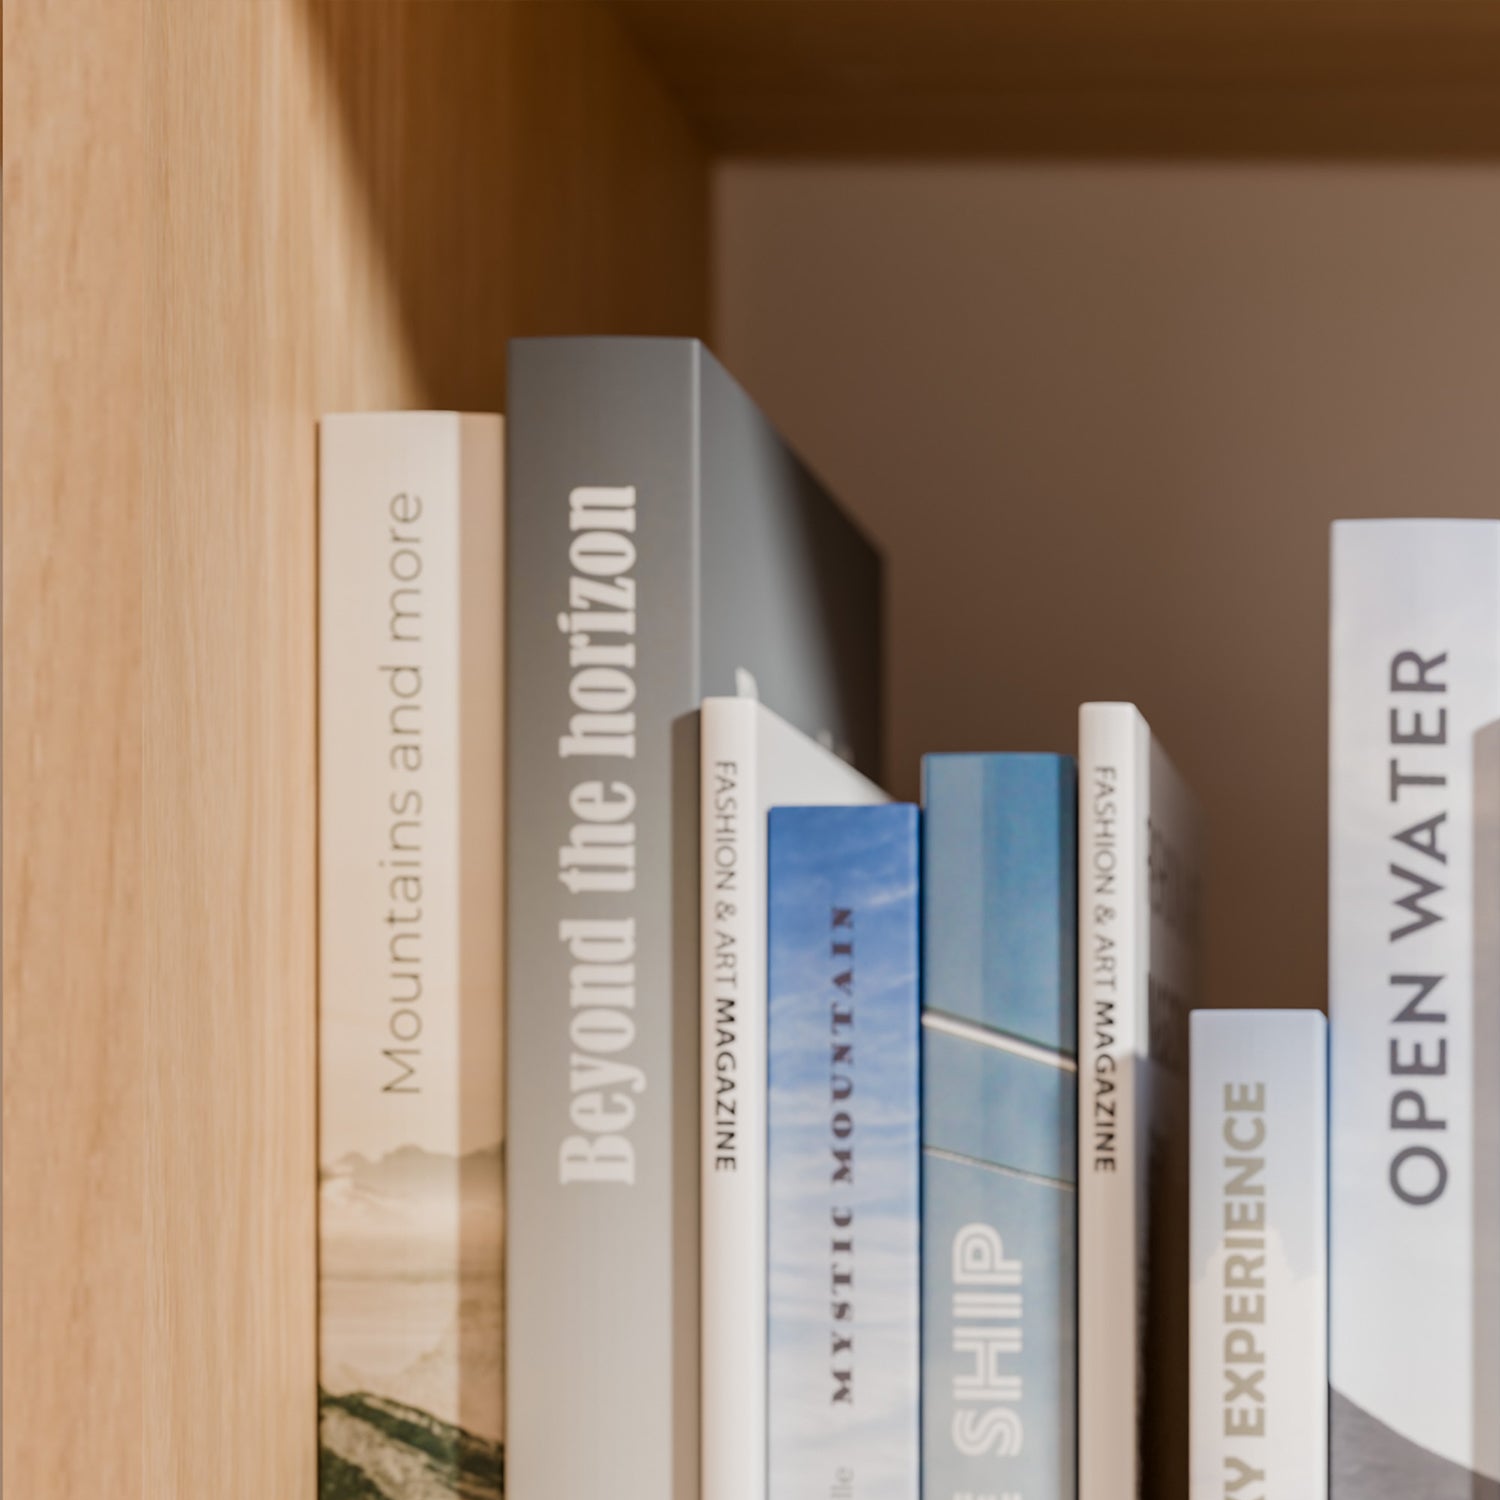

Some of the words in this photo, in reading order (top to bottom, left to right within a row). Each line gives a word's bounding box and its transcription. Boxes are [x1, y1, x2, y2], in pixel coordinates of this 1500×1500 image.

[388, 492, 422, 643] more
[558, 485, 637, 759] horizon
[379, 665, 422, 773] and
[1389, 648, 1448, 944] WATER
[559, 781, 637, 893] the
[714, 760, 736, 891] FASHION
[714, 901, 736, 921] &
[1093, 765, 1116, 896] FASHION
[379, 790, 422, 1094] Mountains
[714, 930, 736, 988] ART
[1093, 904, 1116, 925] &
[1093, 933, 1116, 990] ART
[559, 919, 646, 1185] Beyond
[714, 997, 736, 1172] MAGAZINE
[831, 905, 854, 1185] MOUNTAIN
[1093, 1001, 1116, 1173] MAGAZINE
[1389, 973, 1448, 1206] OPEN
[831, 1206, 854, 1406] MYSTIC
[952, 1222, 1023, 1458] SHIP
[1223, 1081, 1266, 1439] EXPERIENCE
